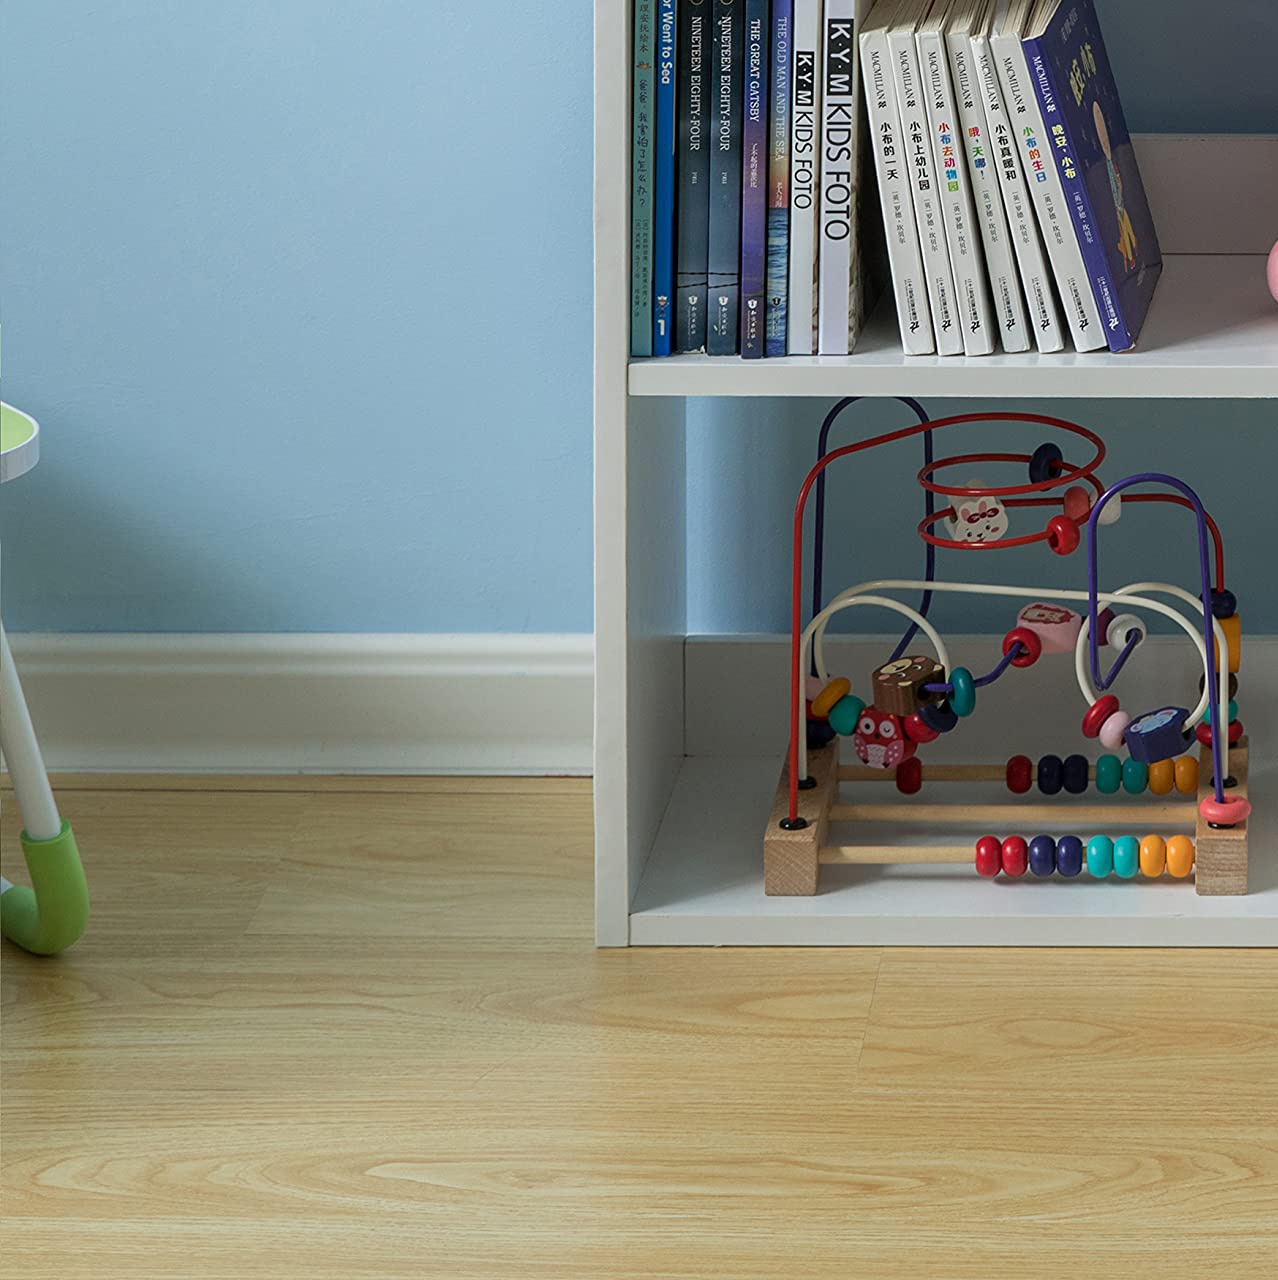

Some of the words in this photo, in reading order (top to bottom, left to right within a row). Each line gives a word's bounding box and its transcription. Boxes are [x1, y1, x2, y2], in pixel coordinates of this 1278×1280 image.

[661, 12, 674, 46] Went
[690, 16, 702, 72] NINETEEN
[720, 16, 732, 72] NINETEEN
[751, 19, 761, 42] THE
[777, 41, 787, 63] OLD
[778, 17, 788, 38] THE
[661, 47, 672, 59] to
[661, 61, 673, 85] Sea
[750, 43, 760, 78] GREAT
[871, 50, 885, 100] MACMILLAN
[899, 50, 914, 99] MACMILLAN
[928, 51, 944, 100] MACMILLAN
[955, 51, 973, 100] MACMILLAN
[749, 81, 760, 122] GATSBY
[776, 67, 787, 89] MAN
[979, 54, 998, 103] MACMILLAN
[1003, 57, 1024, 105] MACMILLAN
[1032, 56, 1053, 104] MACMILLAN
[690, 75, 701, 151] EIGHTY-FOUR
[719, 75, 731, 151] EIGHTY-FOUR
[776, 92, 787, 114] AND
[776, 116, 785, 138] THE
[775, 140, 785, 161] SEA
[795, 111, 813, 153] KIDS
[826, 104, 852, 162] KIDS
[880, 122, 899, 180] 小布的一天
[909, 121, 930, 191] 小布上幼儿园
[995, 124, 1017, 180] 小布真暖和
[1023, 127, 1047, 183] 小布的生日
[938, 122, 959, 192] 小布去动物园
[794, 160, 812, 209] FOTO
[824, 171, 850, 240] FOTO
[658, 320, 665, 335] 1
